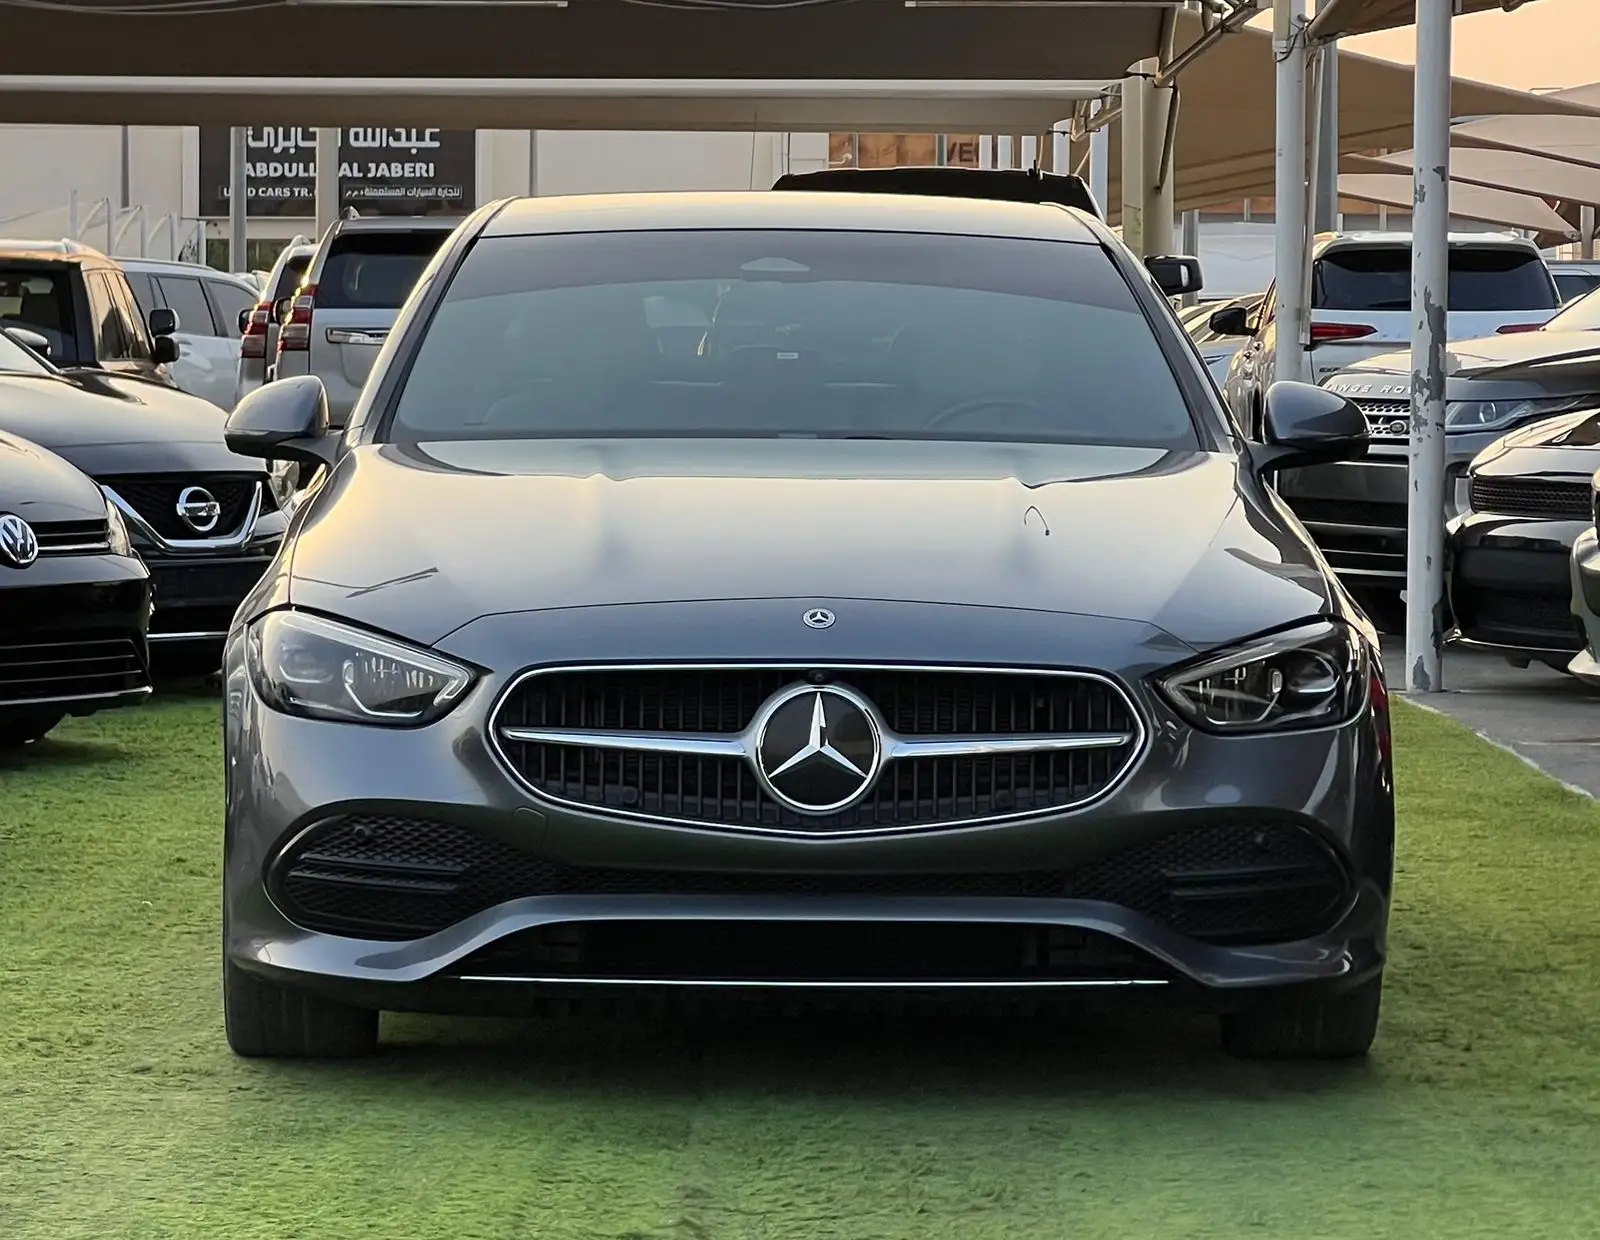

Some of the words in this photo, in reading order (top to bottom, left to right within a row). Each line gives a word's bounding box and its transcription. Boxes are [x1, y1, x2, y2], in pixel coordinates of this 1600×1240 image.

[245, 162, 318, 177] ABDULL
[338, 162, 363, 177] AL
[367, 162, 435, 177] JABERI
[224, 187, 256, 197] UD
[258, 187, 291, 197] CARS
[1325, 383, 1373, 394] ANGE
